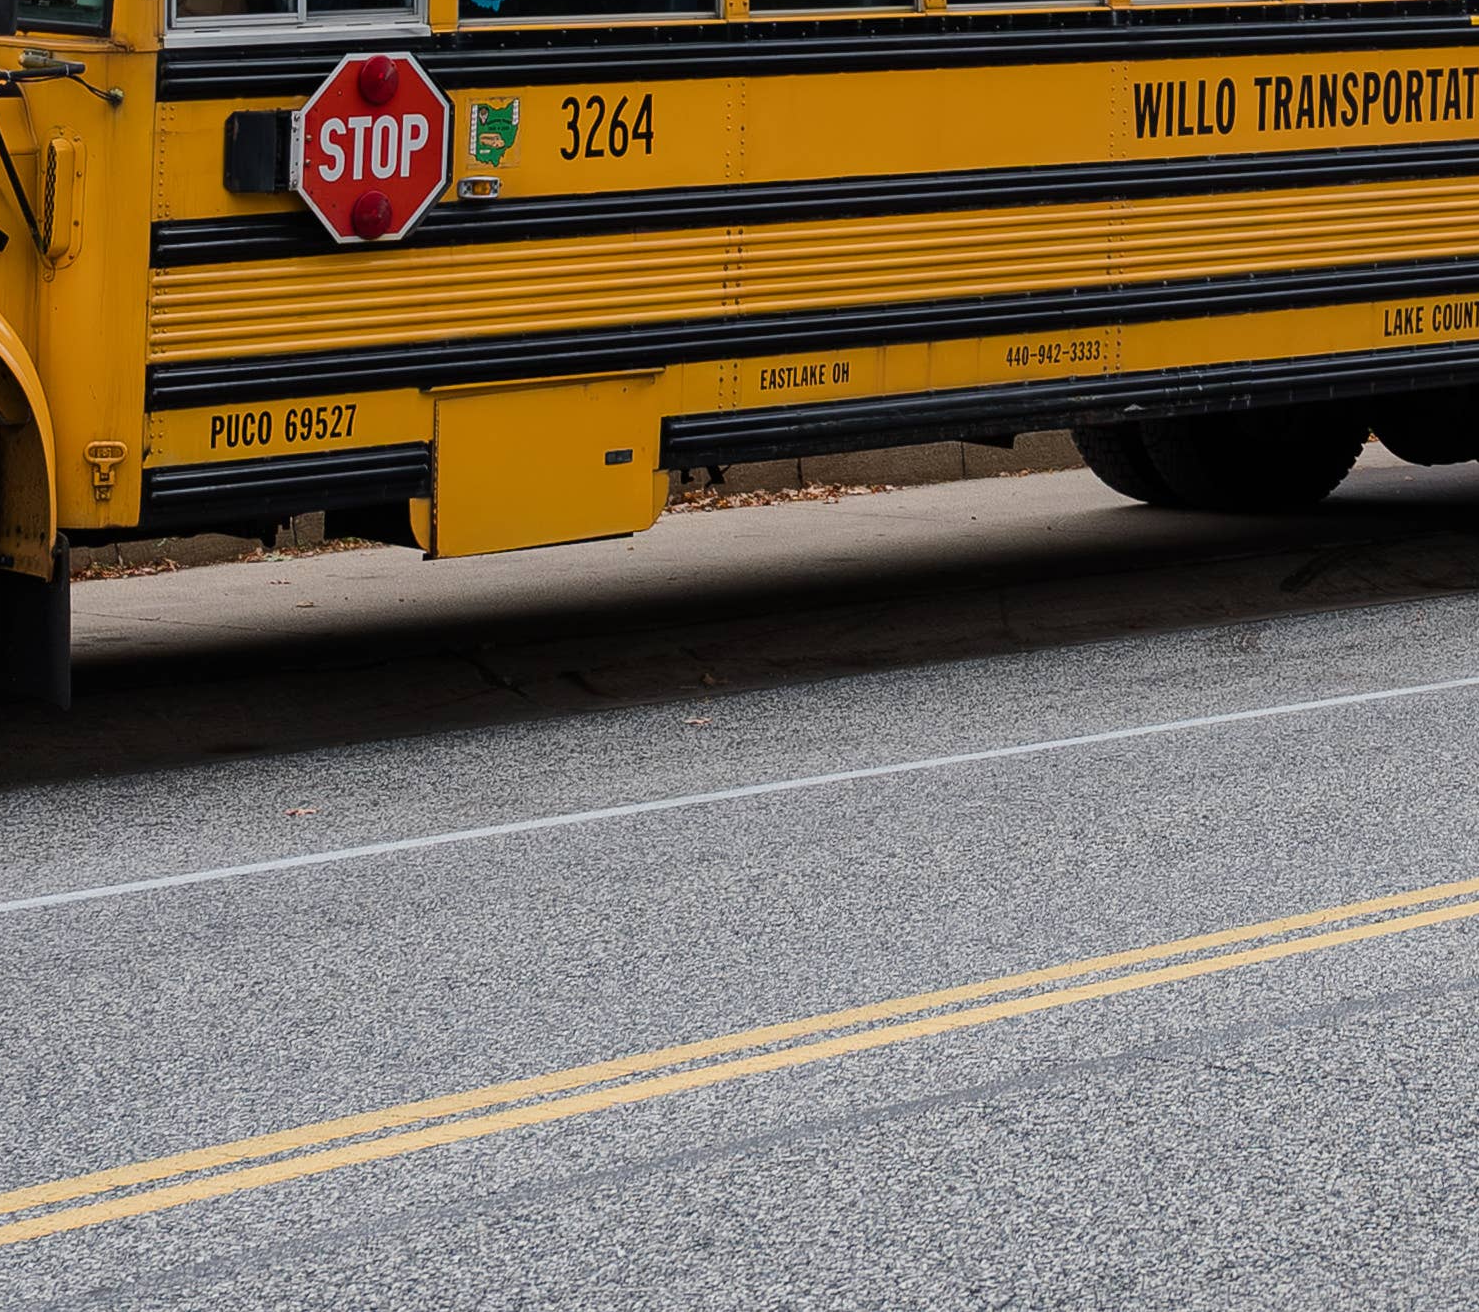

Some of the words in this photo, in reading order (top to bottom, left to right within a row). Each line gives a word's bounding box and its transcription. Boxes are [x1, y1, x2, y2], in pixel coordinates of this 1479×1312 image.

[560, 94, 654, 161] 3264
[1133, 78, 1236, 139] WILLO
[318, 113, 429, 183] STOP
[1384, 305, 1424, 337] LAKE
[760, 364, 826, 391] EASTLAKE
[832, 362, 850, 384] OH
[1006, 340, 1102, 367] 440-942-3333
[210, 410, 271, 450] PUCO
[284, 403, 358, 443] 69527
